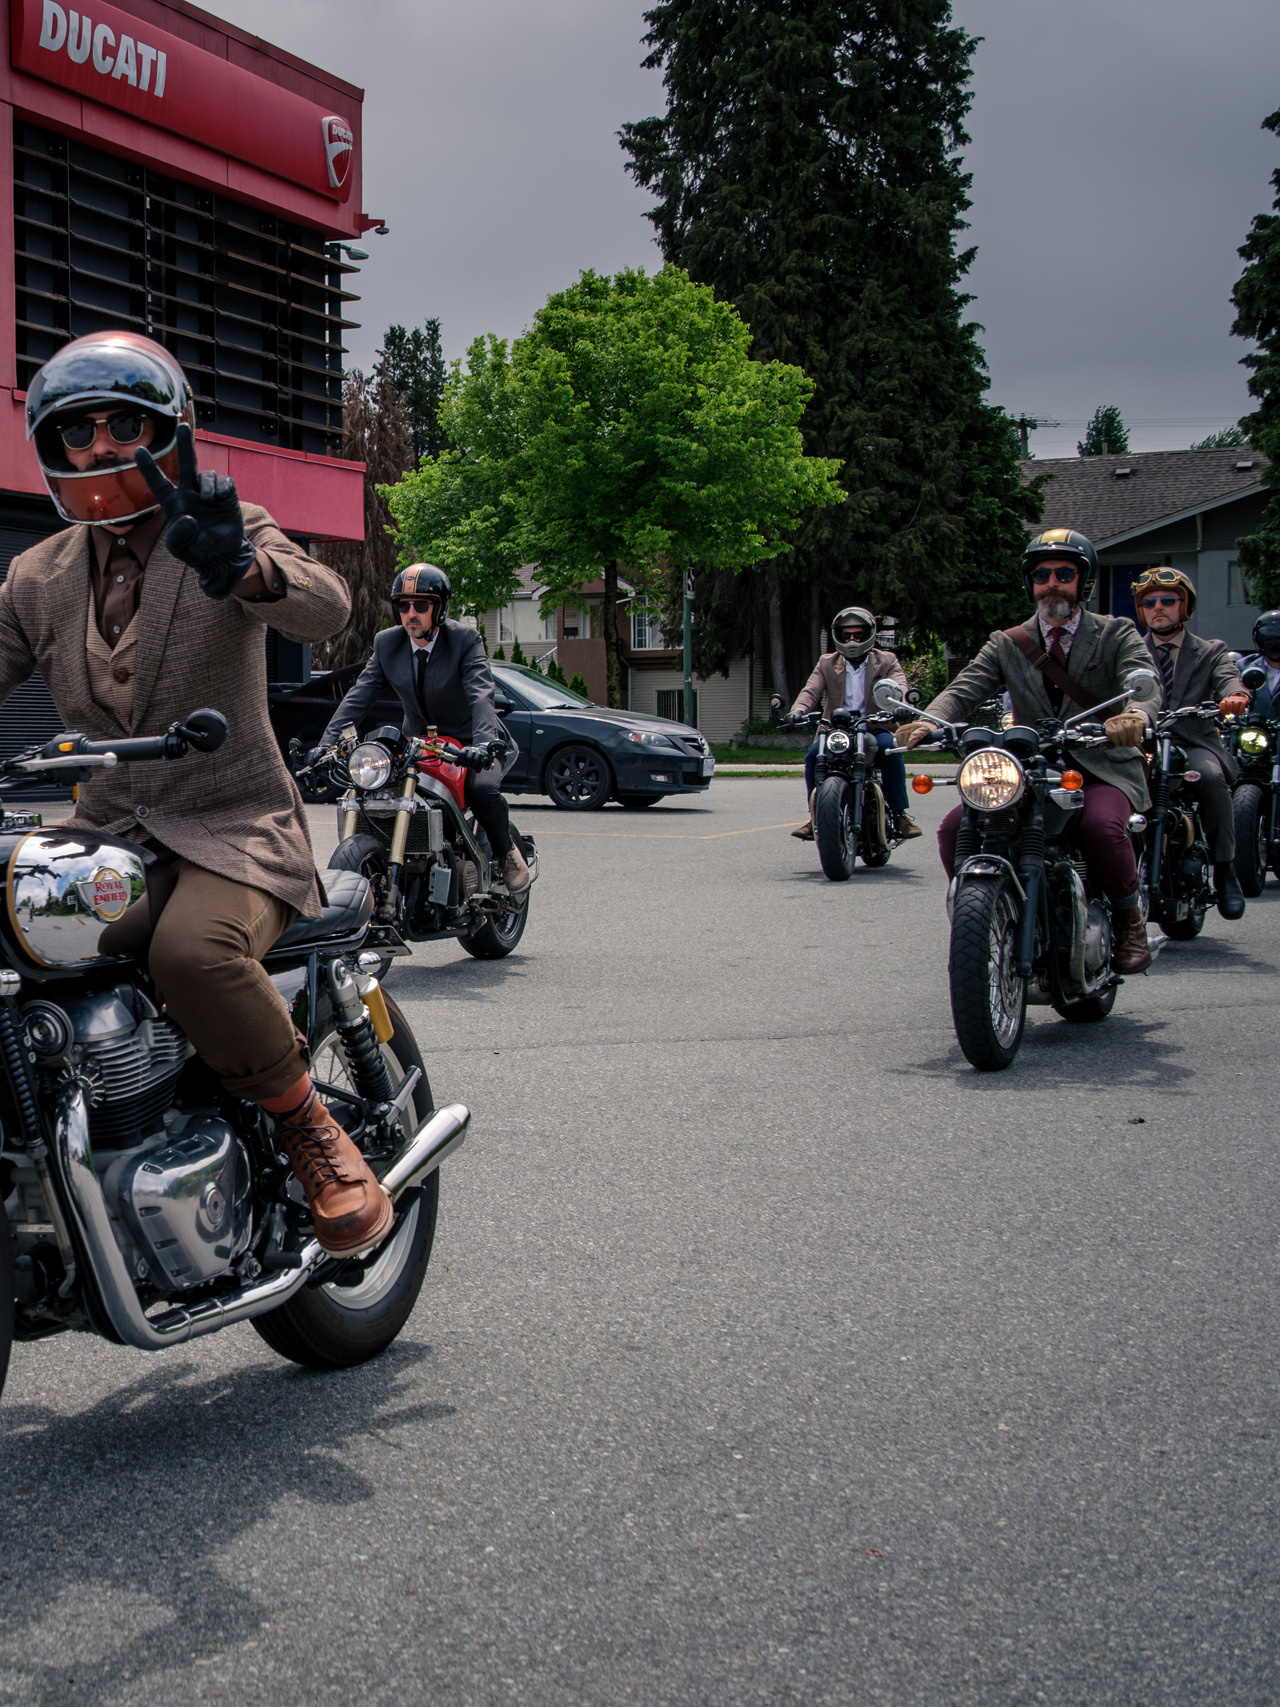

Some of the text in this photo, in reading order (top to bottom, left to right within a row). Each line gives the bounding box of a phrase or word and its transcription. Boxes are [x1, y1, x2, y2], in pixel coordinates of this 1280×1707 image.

[38, 0, 168, 98] DUCATI
[94, 881, 123, 892] ROYAL
[93, 891, 128, 905] ENFIELD
